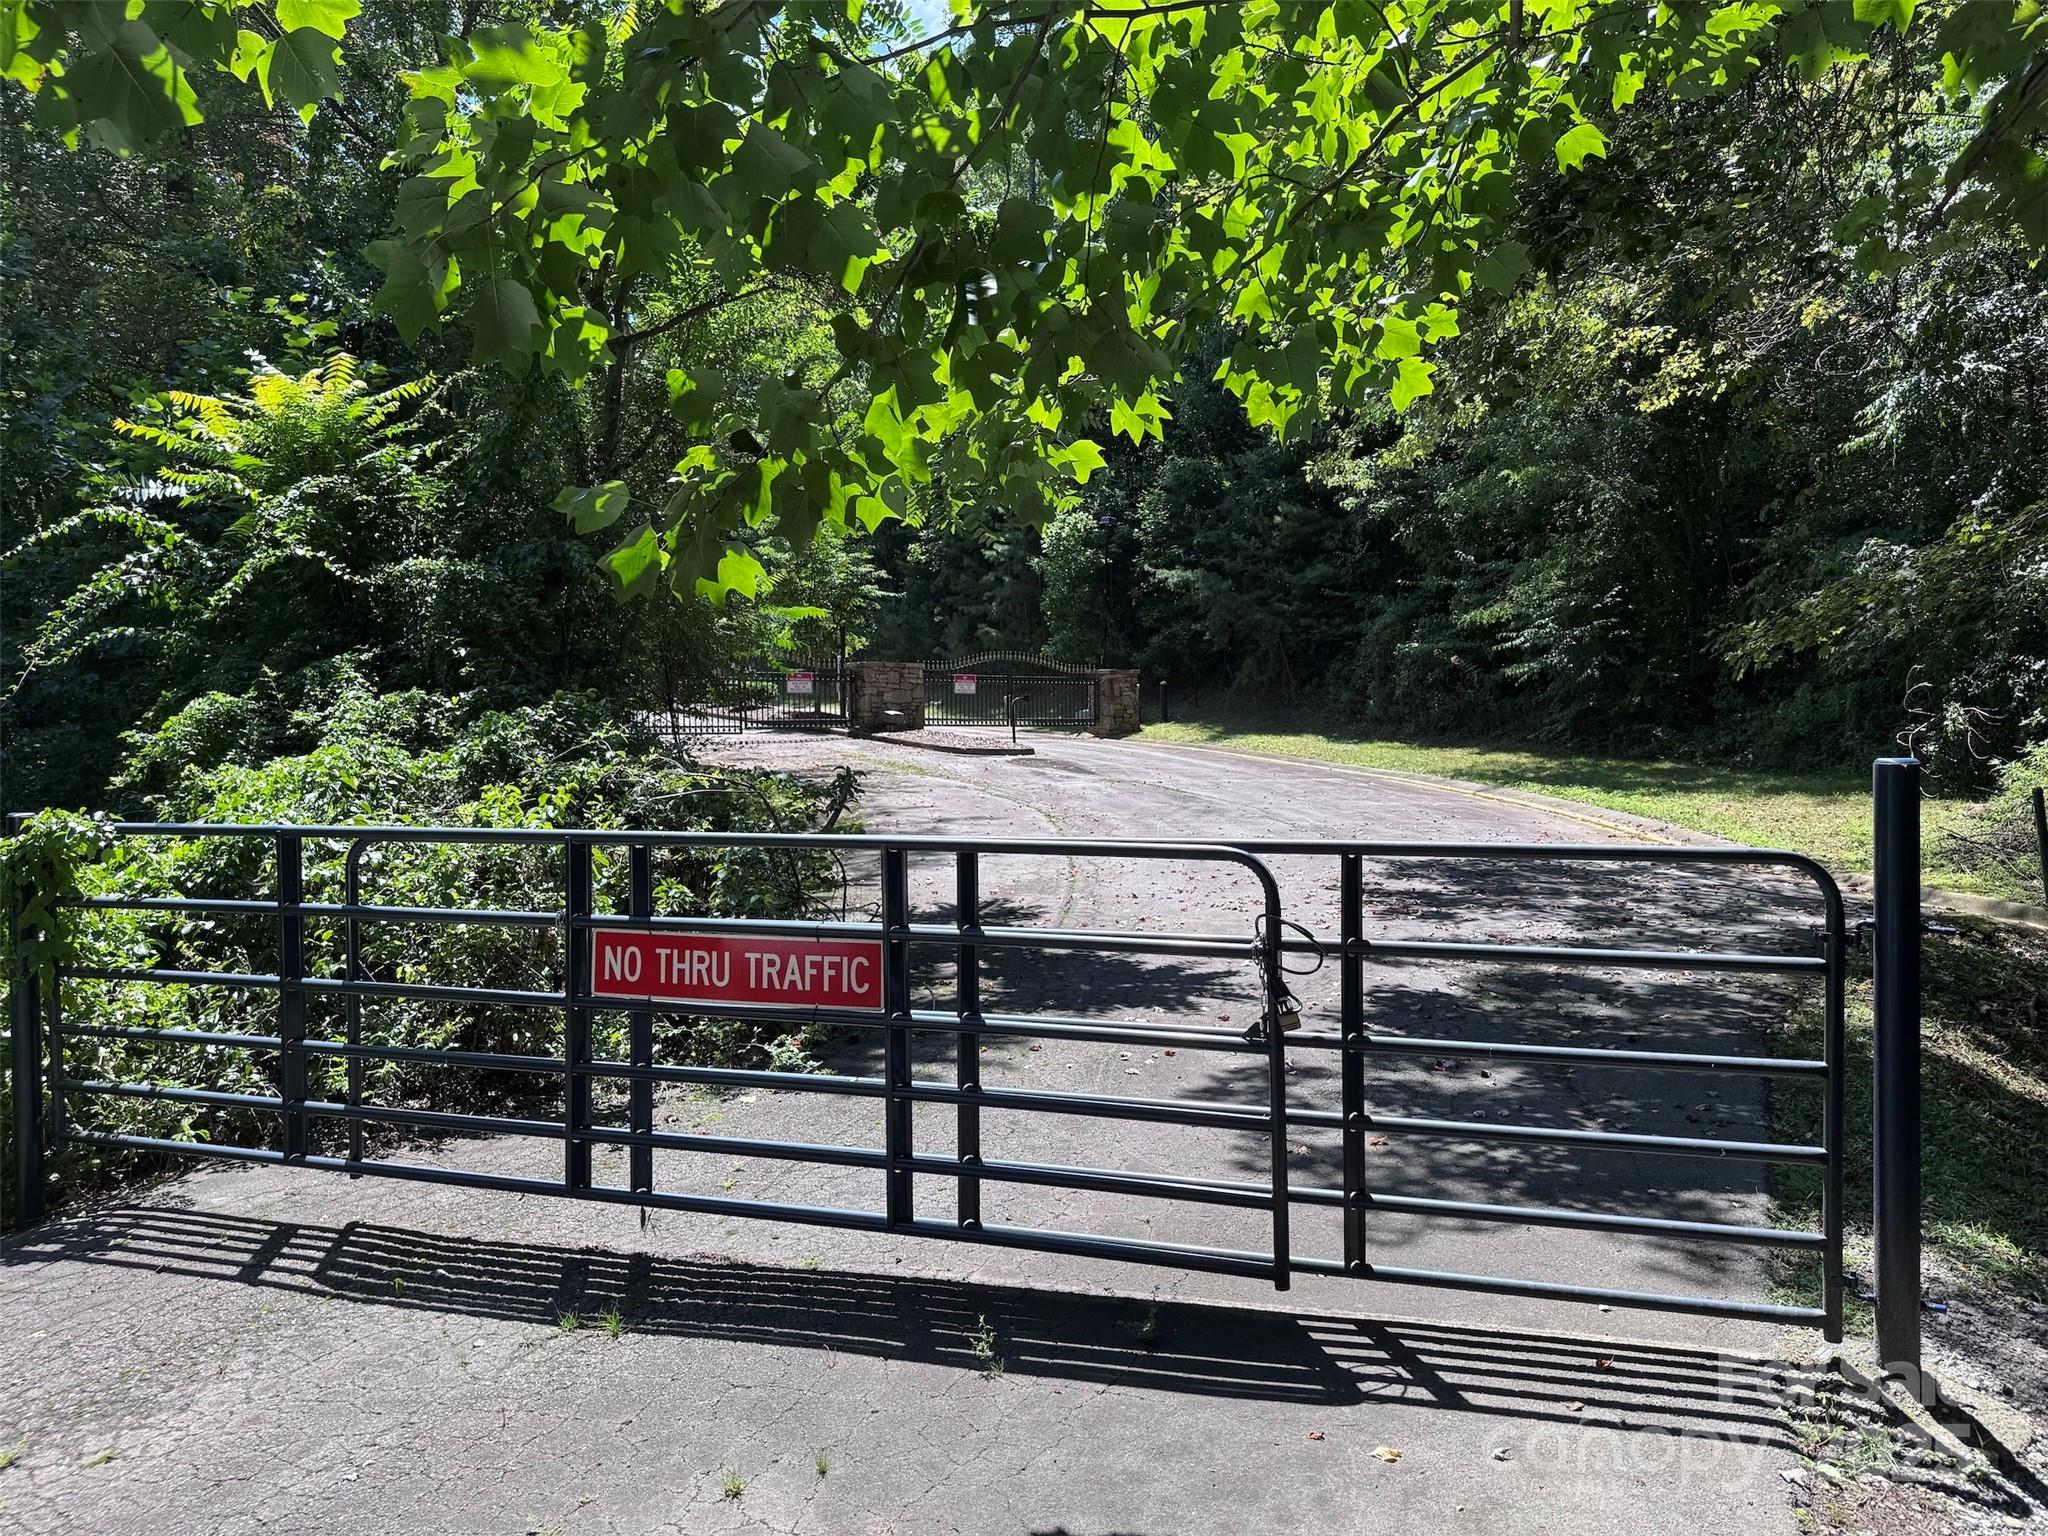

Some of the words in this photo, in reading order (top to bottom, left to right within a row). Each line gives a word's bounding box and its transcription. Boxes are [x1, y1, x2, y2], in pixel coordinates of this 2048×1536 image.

[604, 945, 642, 982] NO
[655, 948, 730, 988] THRU
[744, 952, 870, 994] TRAFFIC
